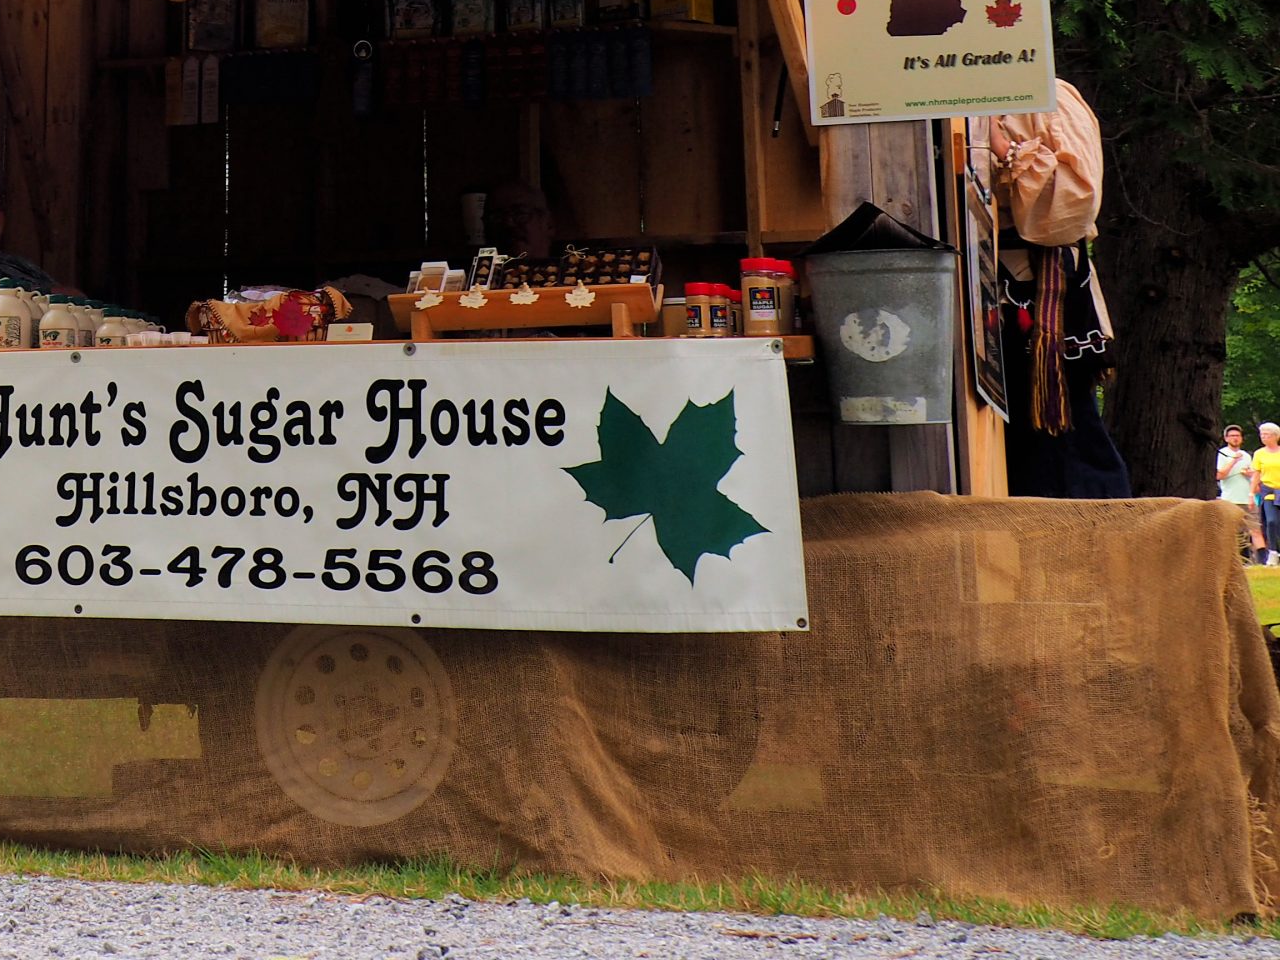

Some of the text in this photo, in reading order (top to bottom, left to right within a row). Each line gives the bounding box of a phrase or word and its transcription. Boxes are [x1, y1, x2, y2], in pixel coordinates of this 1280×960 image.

[903, 48, 1036, 70] It's All Grade A!
[904, 93, 1034, 107] www.nhmapleproducers.com
[168, 379, 344, 464] Sugar
[364, 378, 566, 465] House
[55, 471, 451, 531] Hillsboro, NH
[14, 543, 499, 595] 603-478-5568
